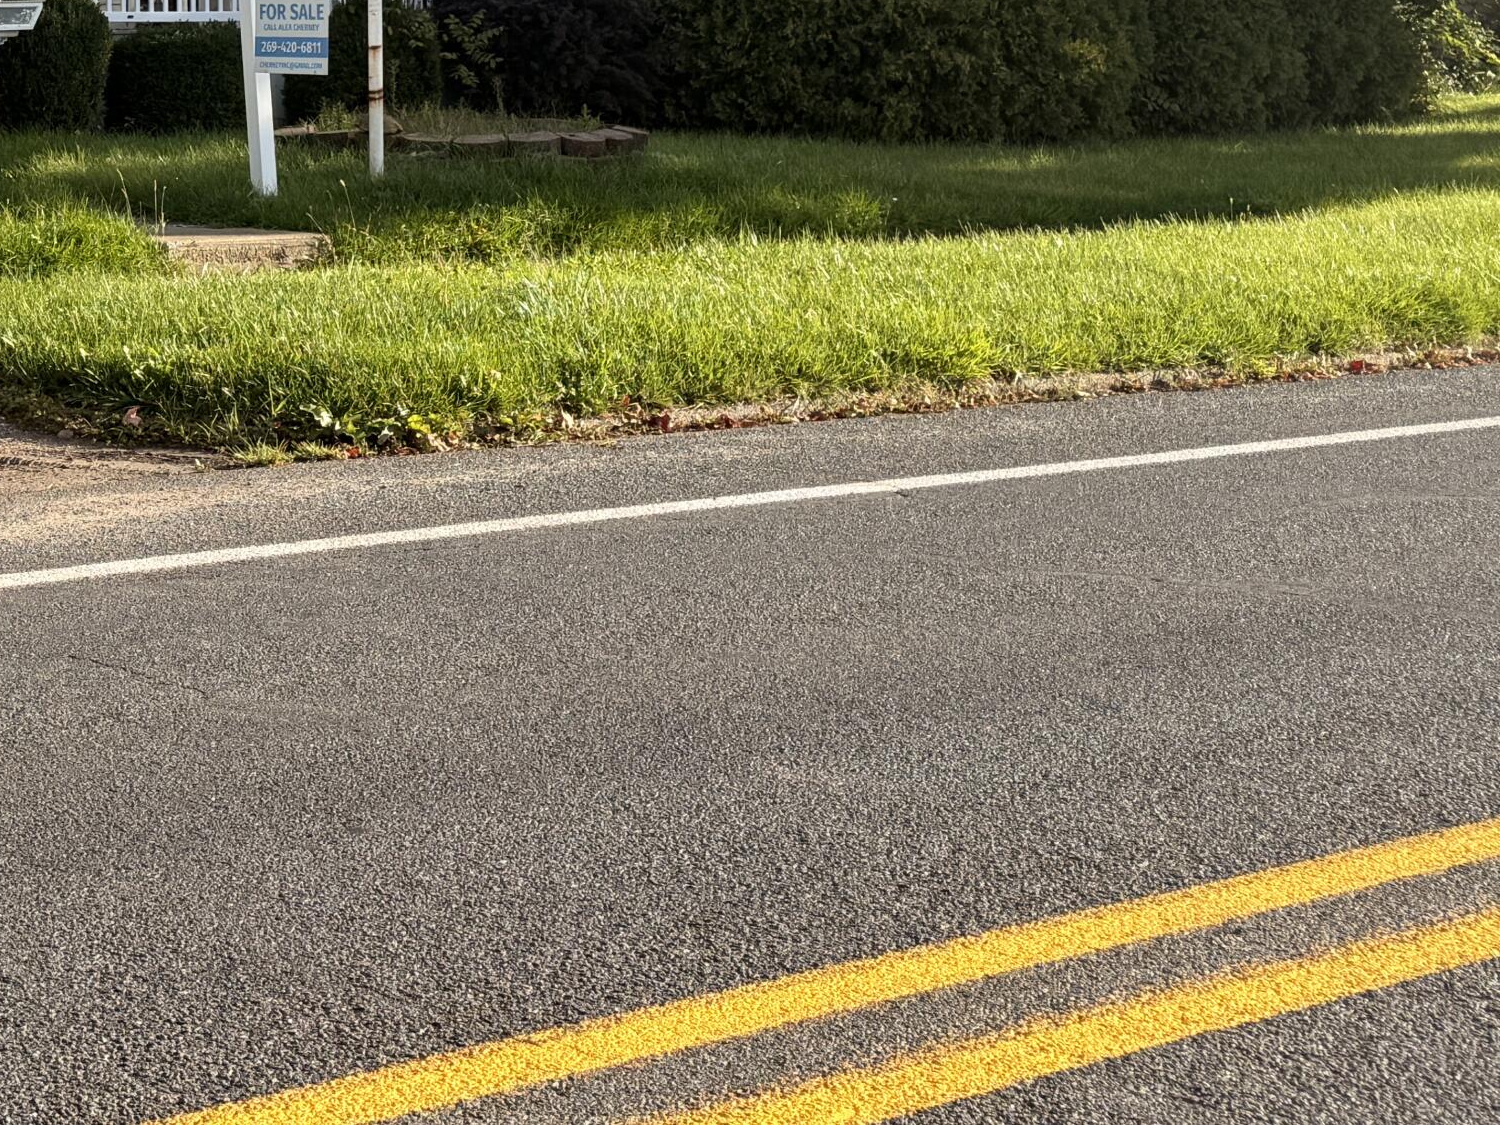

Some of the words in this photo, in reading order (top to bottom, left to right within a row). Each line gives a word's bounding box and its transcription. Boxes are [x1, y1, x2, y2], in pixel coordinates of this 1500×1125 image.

[260, 3, 286, 20] FOR
[290, 3, 325, 20] SALE
[263, 23, 277, 31] CALL
[261, 41, 321, 53] 269-420-6811
